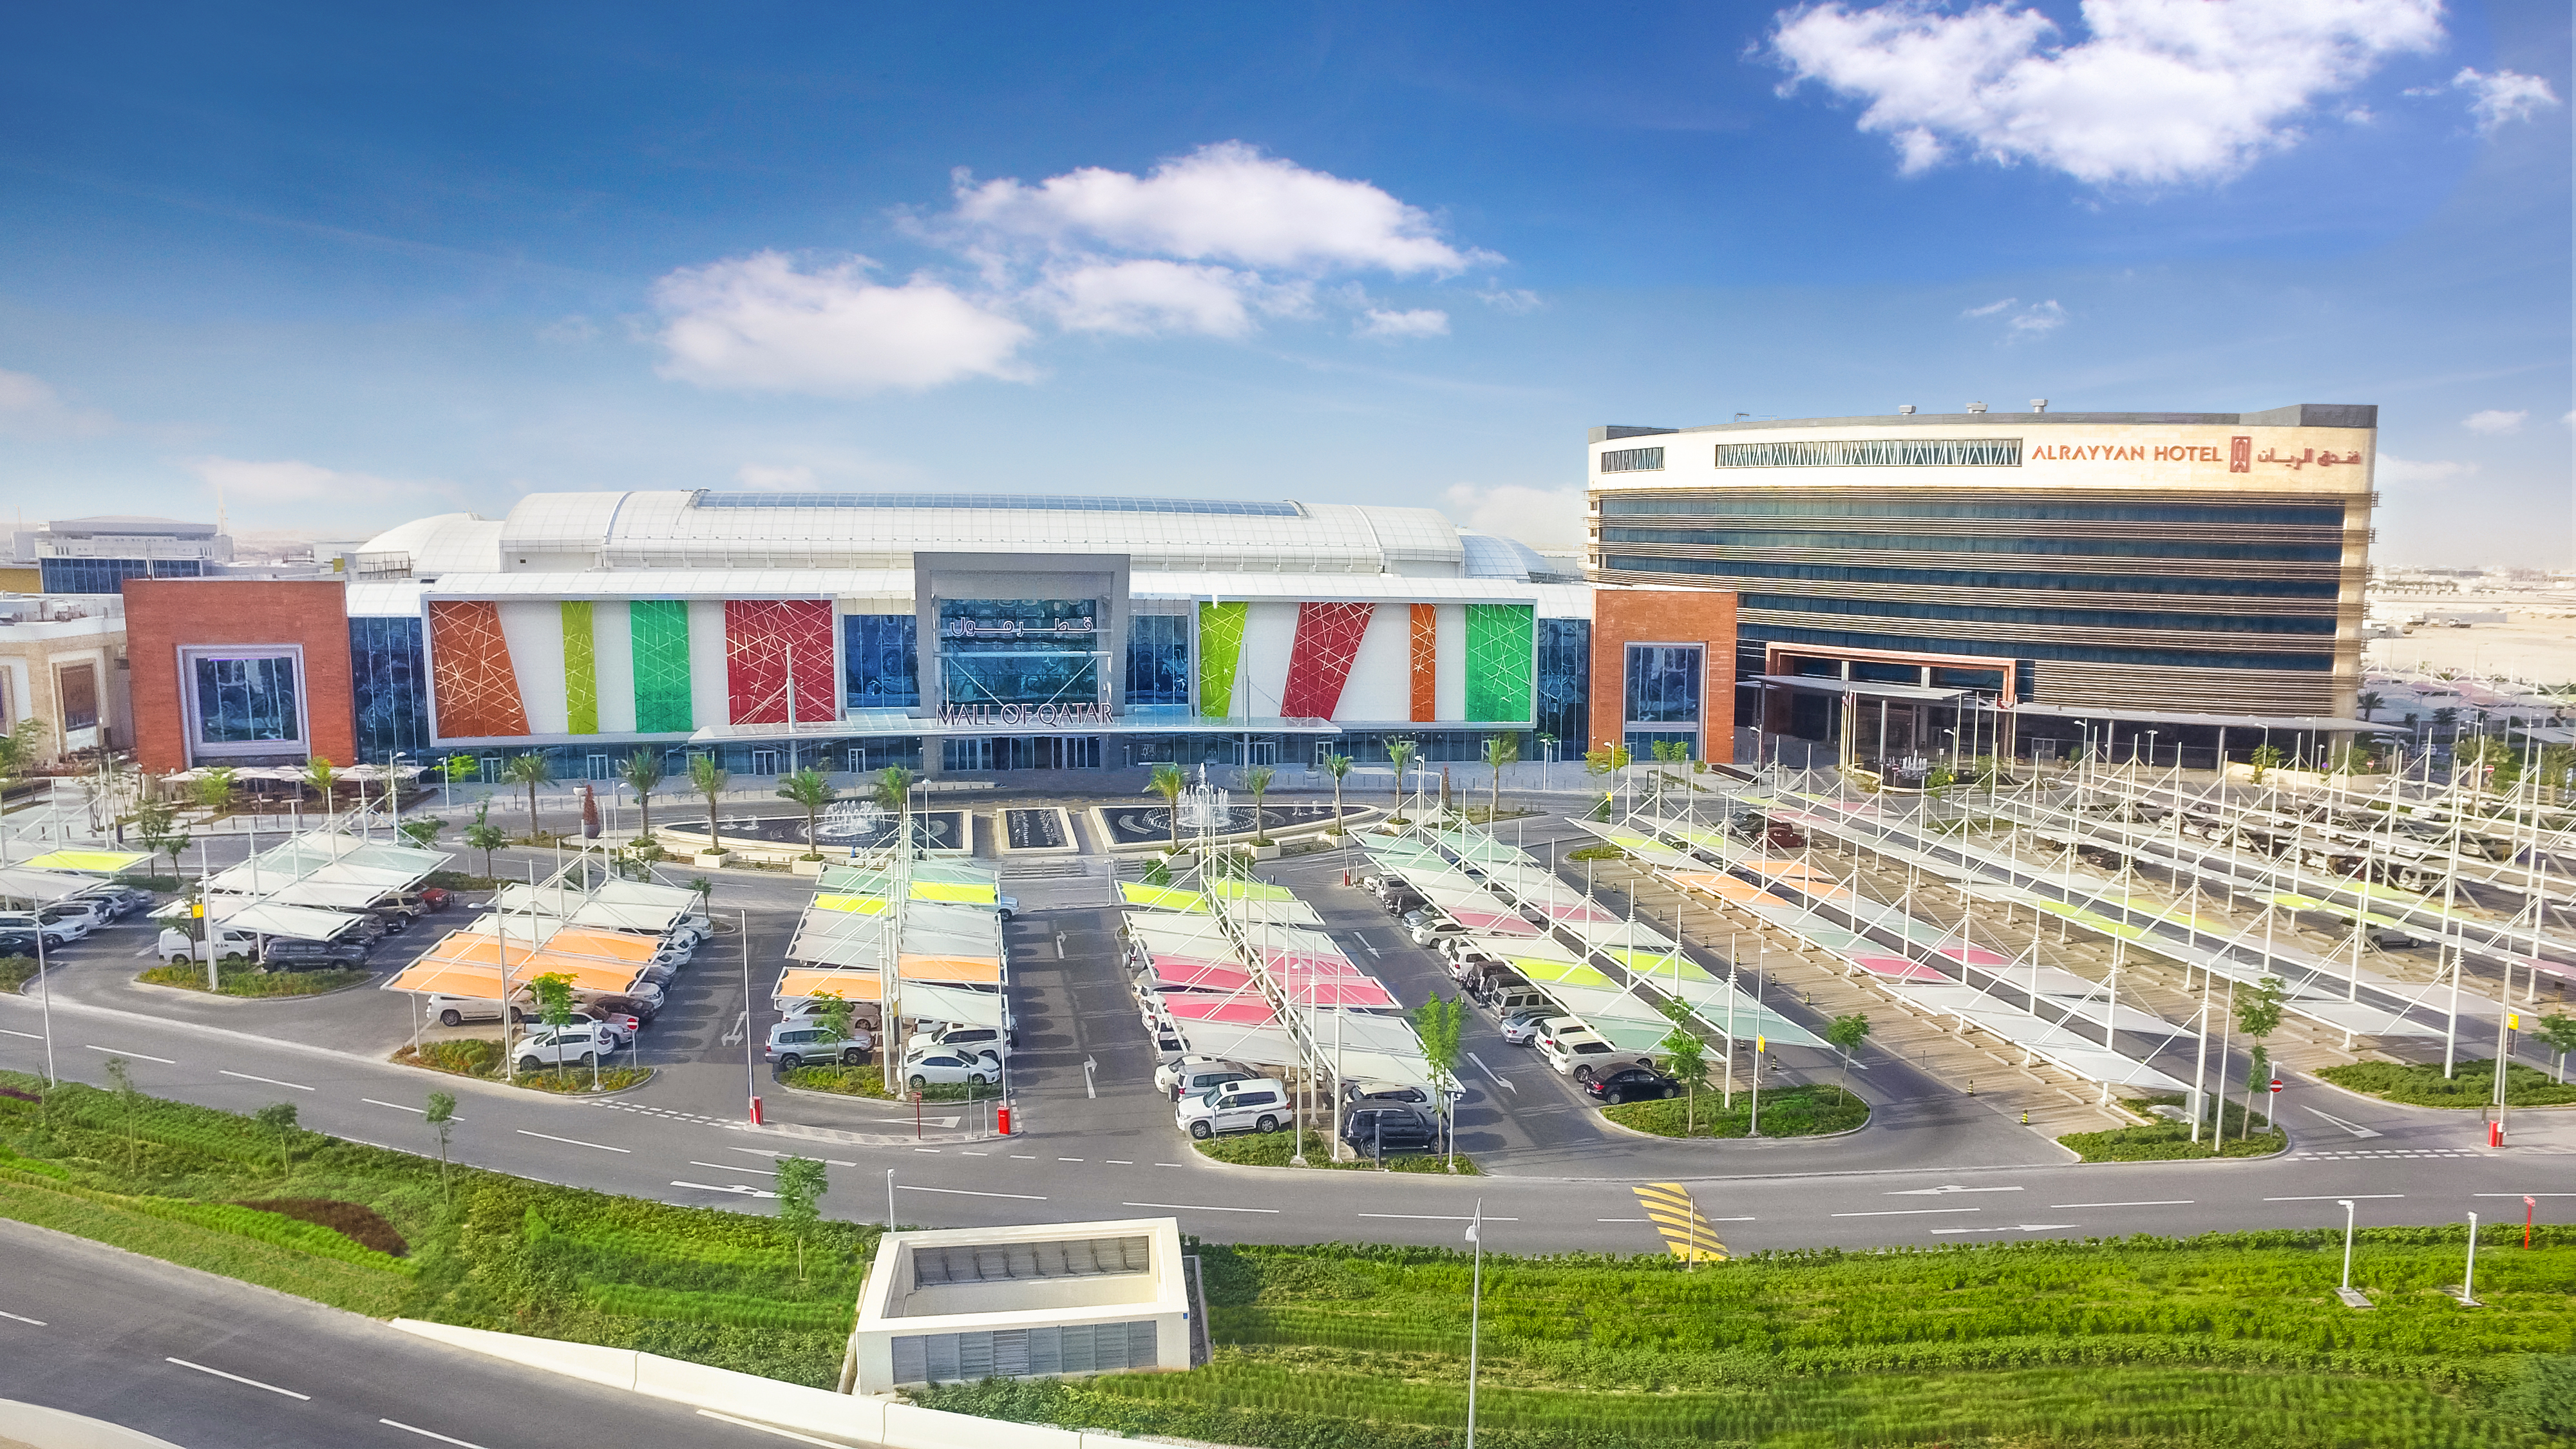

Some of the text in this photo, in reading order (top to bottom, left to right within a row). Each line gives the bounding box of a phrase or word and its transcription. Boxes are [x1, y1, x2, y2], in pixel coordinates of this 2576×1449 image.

[2032, 445, 2223, 462] ALRAYYAN HOTEL
[2257, 447, 2361, 470] فندق الريان
[950, 616, 1094, 637] قطر مول
[936, 701, 1114, 728] MALL OF QATAR
